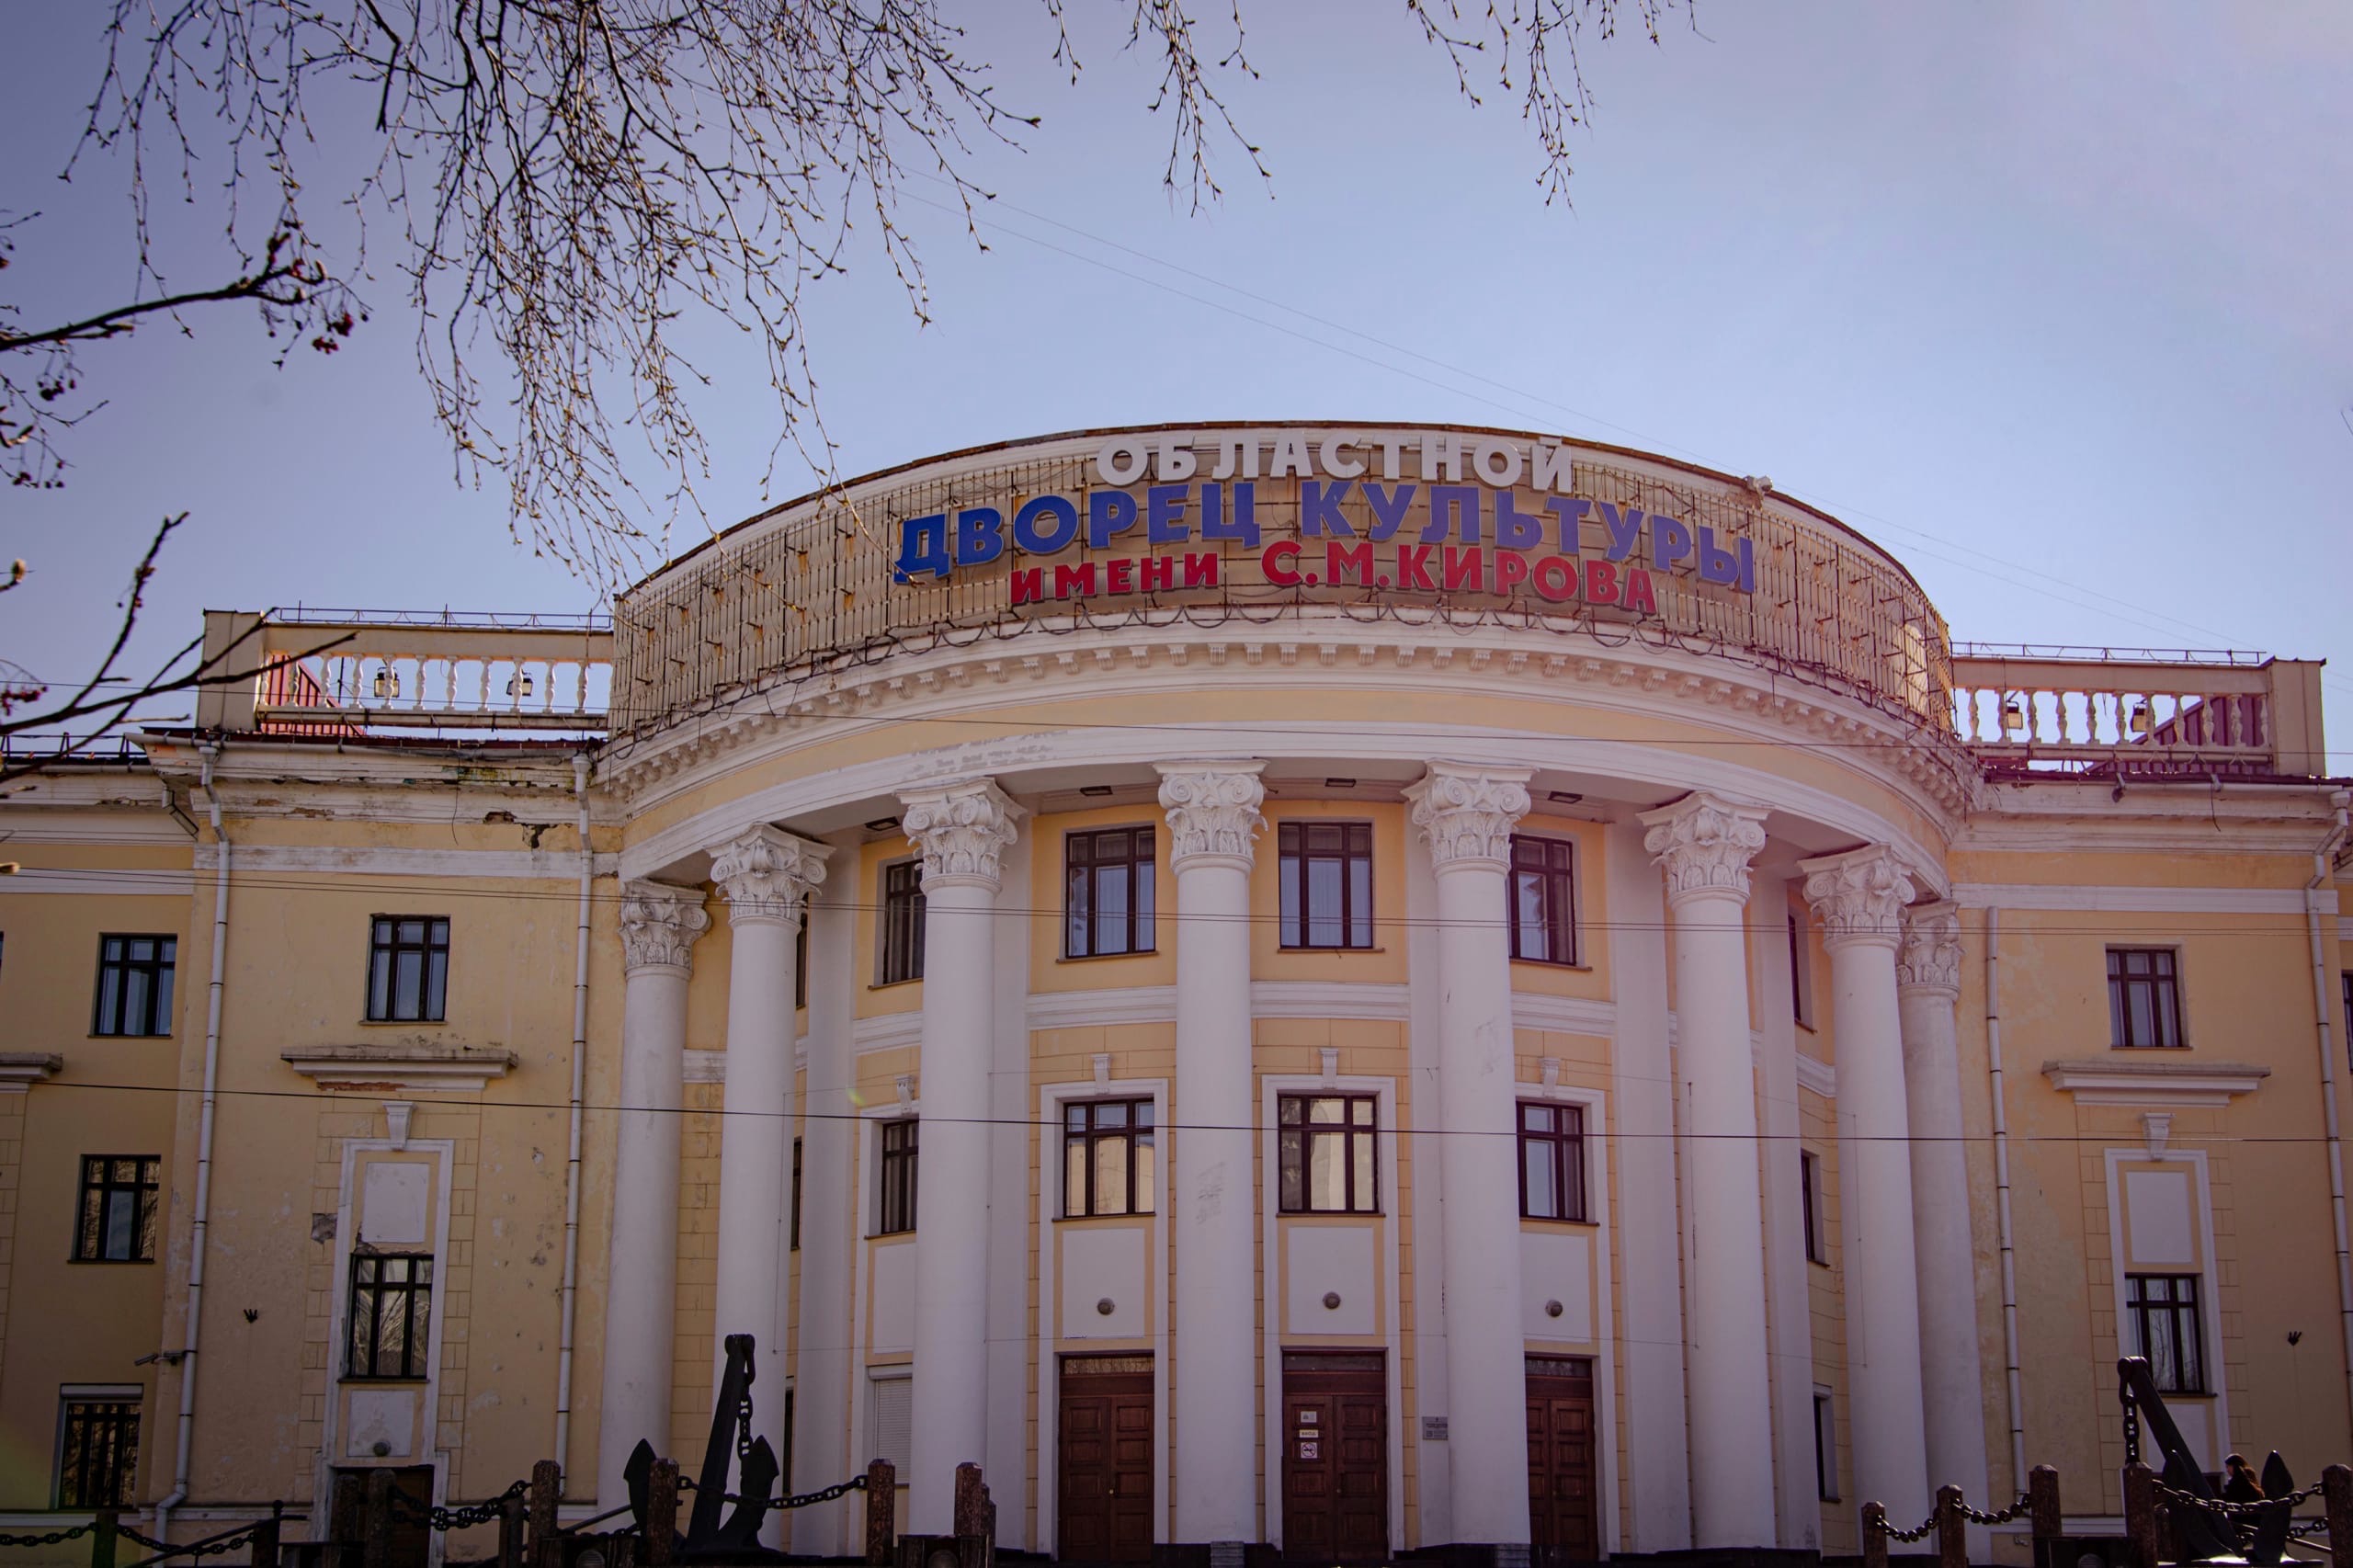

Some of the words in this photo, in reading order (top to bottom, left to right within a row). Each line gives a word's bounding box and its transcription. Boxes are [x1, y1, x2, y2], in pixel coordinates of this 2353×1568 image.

[1097, 429, 1573, 494] ОБЛАСТНОЙ
[894, 482, 1261, 584] ДВОРЕЦ
[1302, 481, 1755, 594] КУЛЬТУРЫ
[1011, 551, 1219, 604] ИМЕНИ
